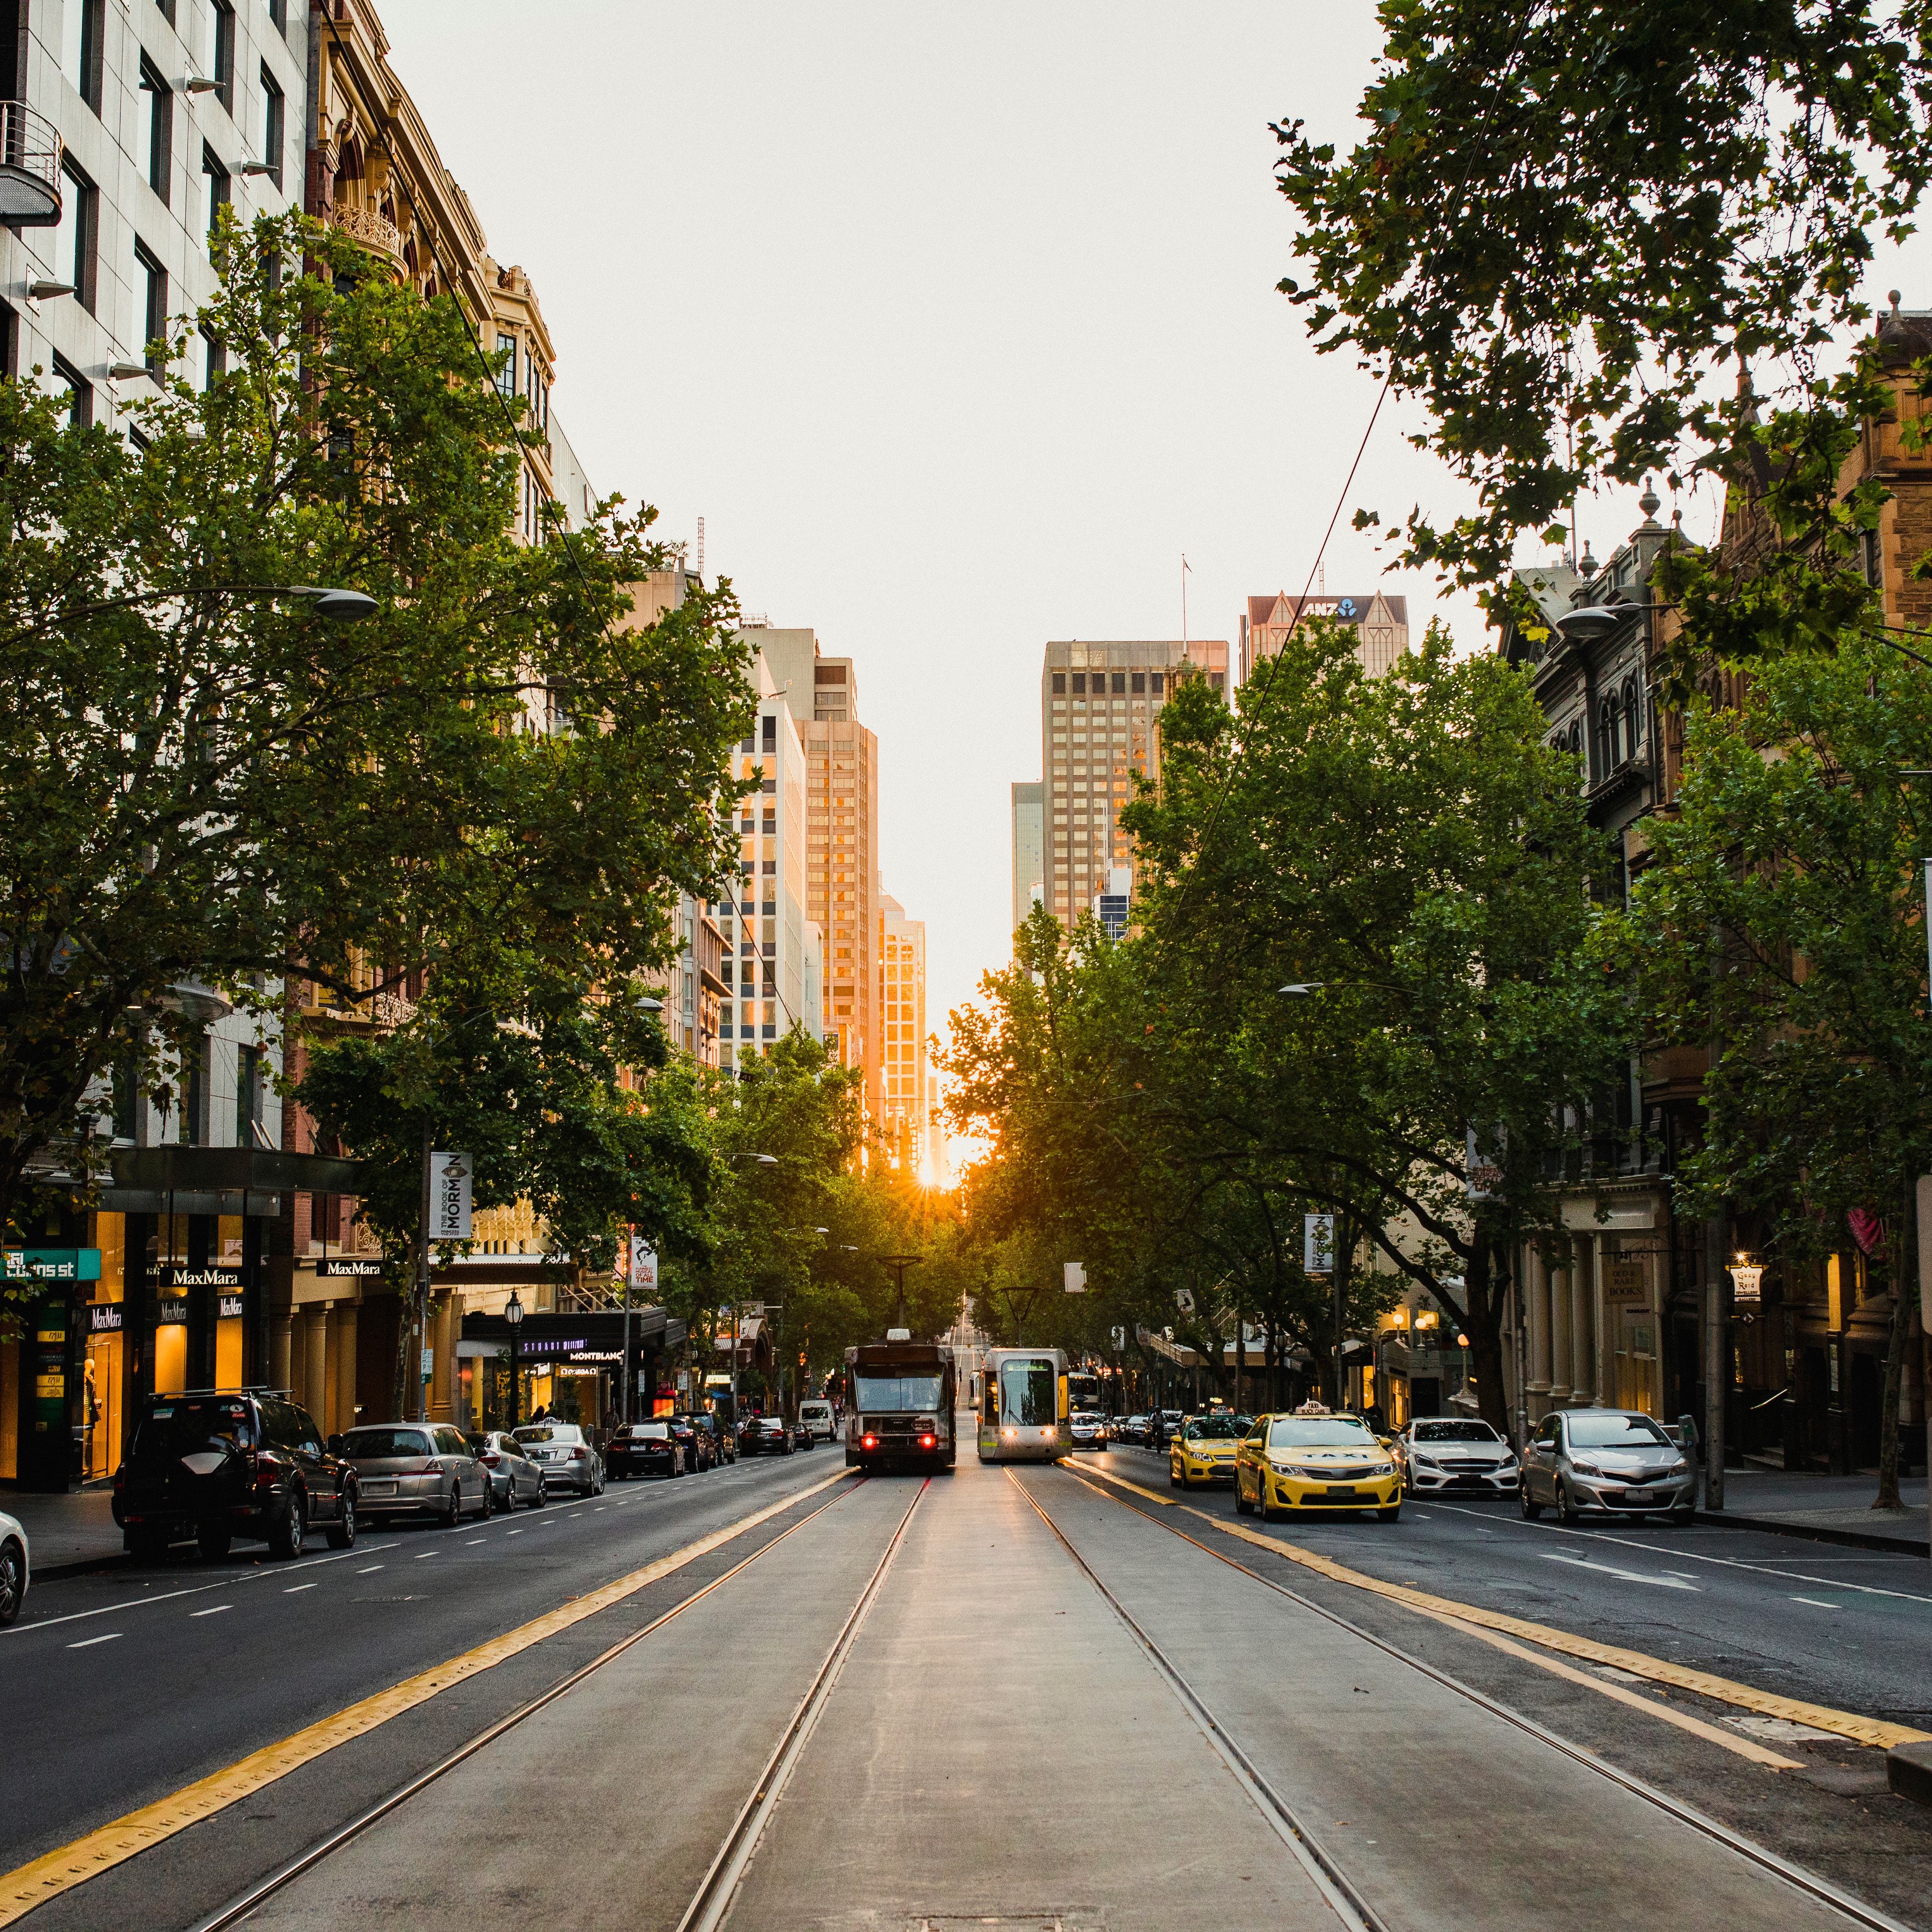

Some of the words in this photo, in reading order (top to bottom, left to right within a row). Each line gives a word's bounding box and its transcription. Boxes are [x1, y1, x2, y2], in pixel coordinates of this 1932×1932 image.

[1302, 603, 1338, 616] ANZ
[442, 1179, 448, 1189] OF
[327, 1262, 380, 1275] MaxMara
[172, 1269, 237, 1284] MaxMara
[1610, 1287, 1641, 1296] BOOKS
[161, 1302, 186, 1322] MaxMara
[220, 1297, 242, 1316] MaxMara
[92, 1308, 121, 1330] MaxMara
